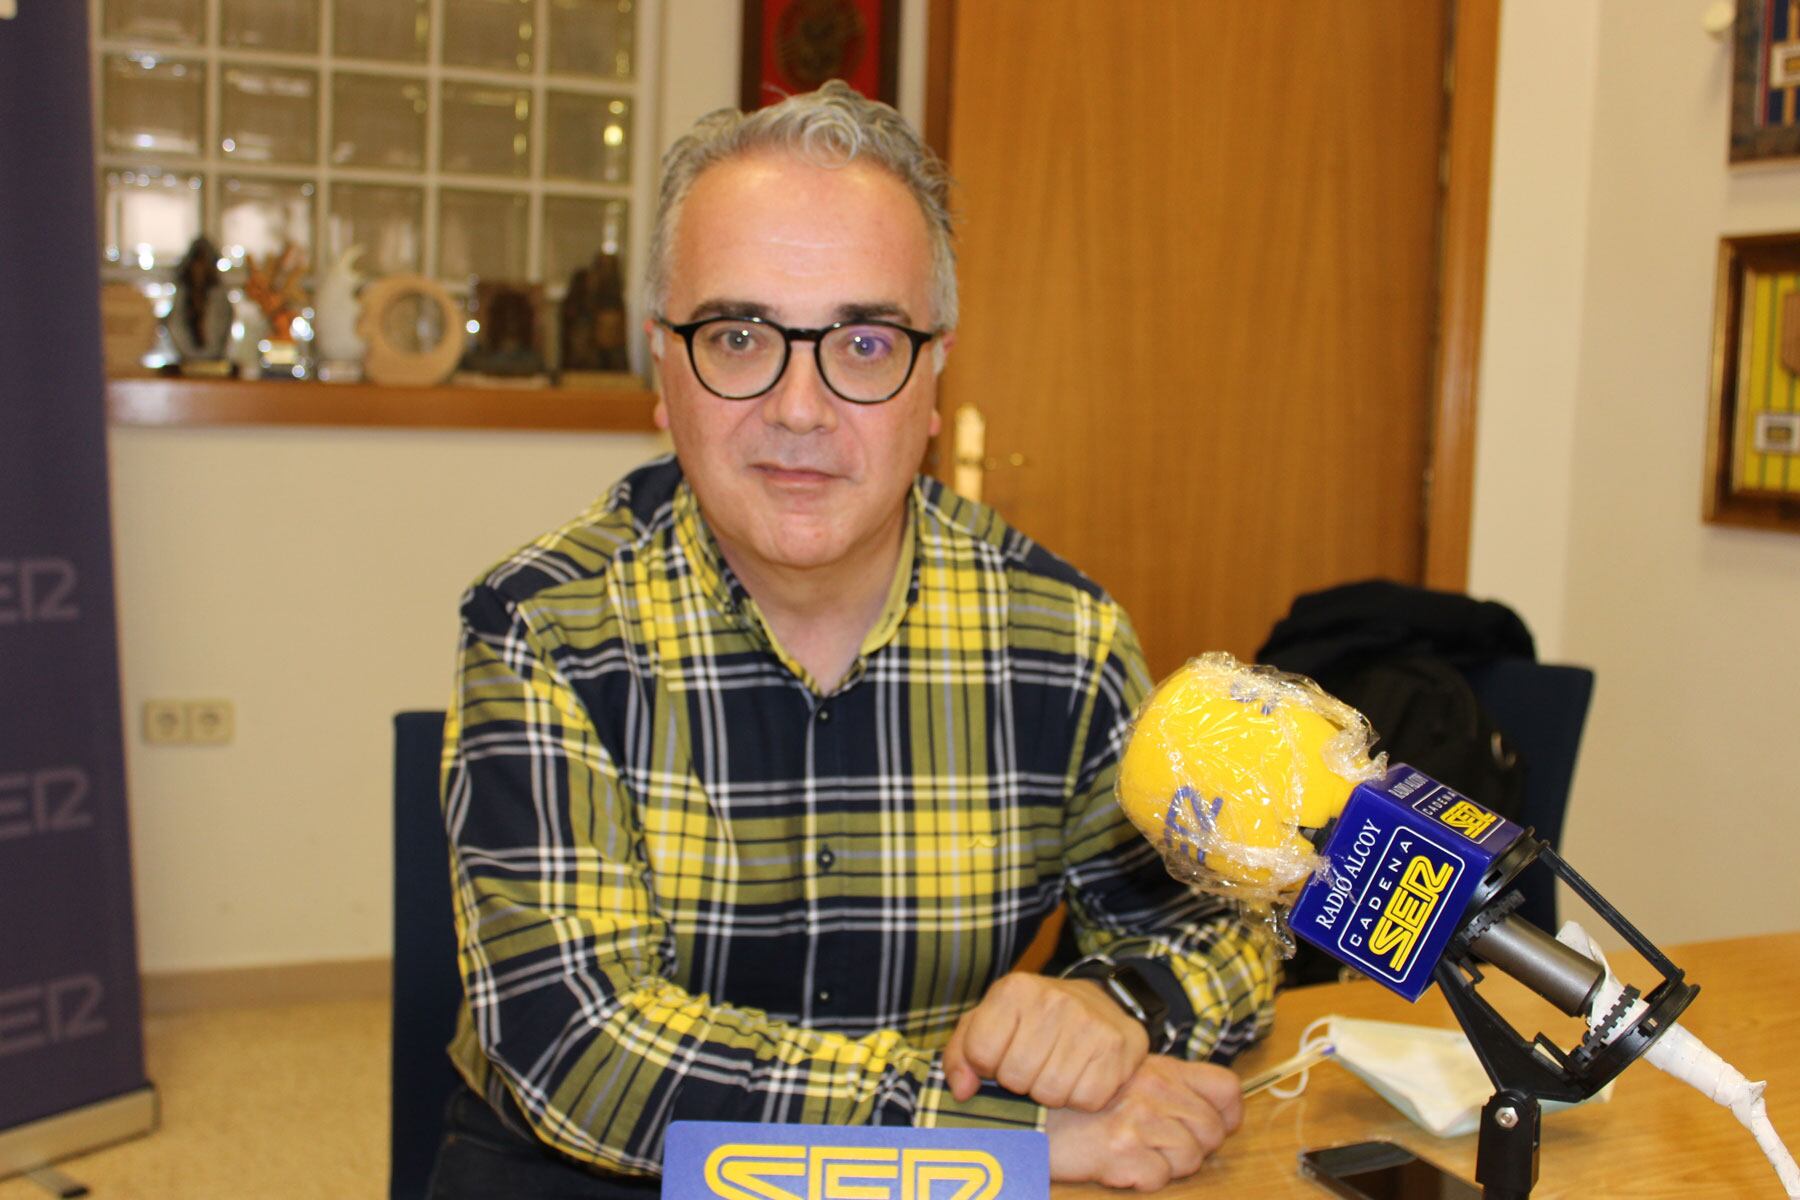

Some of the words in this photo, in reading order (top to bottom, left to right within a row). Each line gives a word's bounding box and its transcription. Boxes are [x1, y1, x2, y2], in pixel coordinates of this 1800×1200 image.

[1440, 801, 1497, 839] SER
[1316, 876, 1352, 930] RADIO
[1345, 819, 1381, 878] ALCOY
[1350, 841, 1412, 947] CADENA
[1368, 855, 1454, 971] SER
